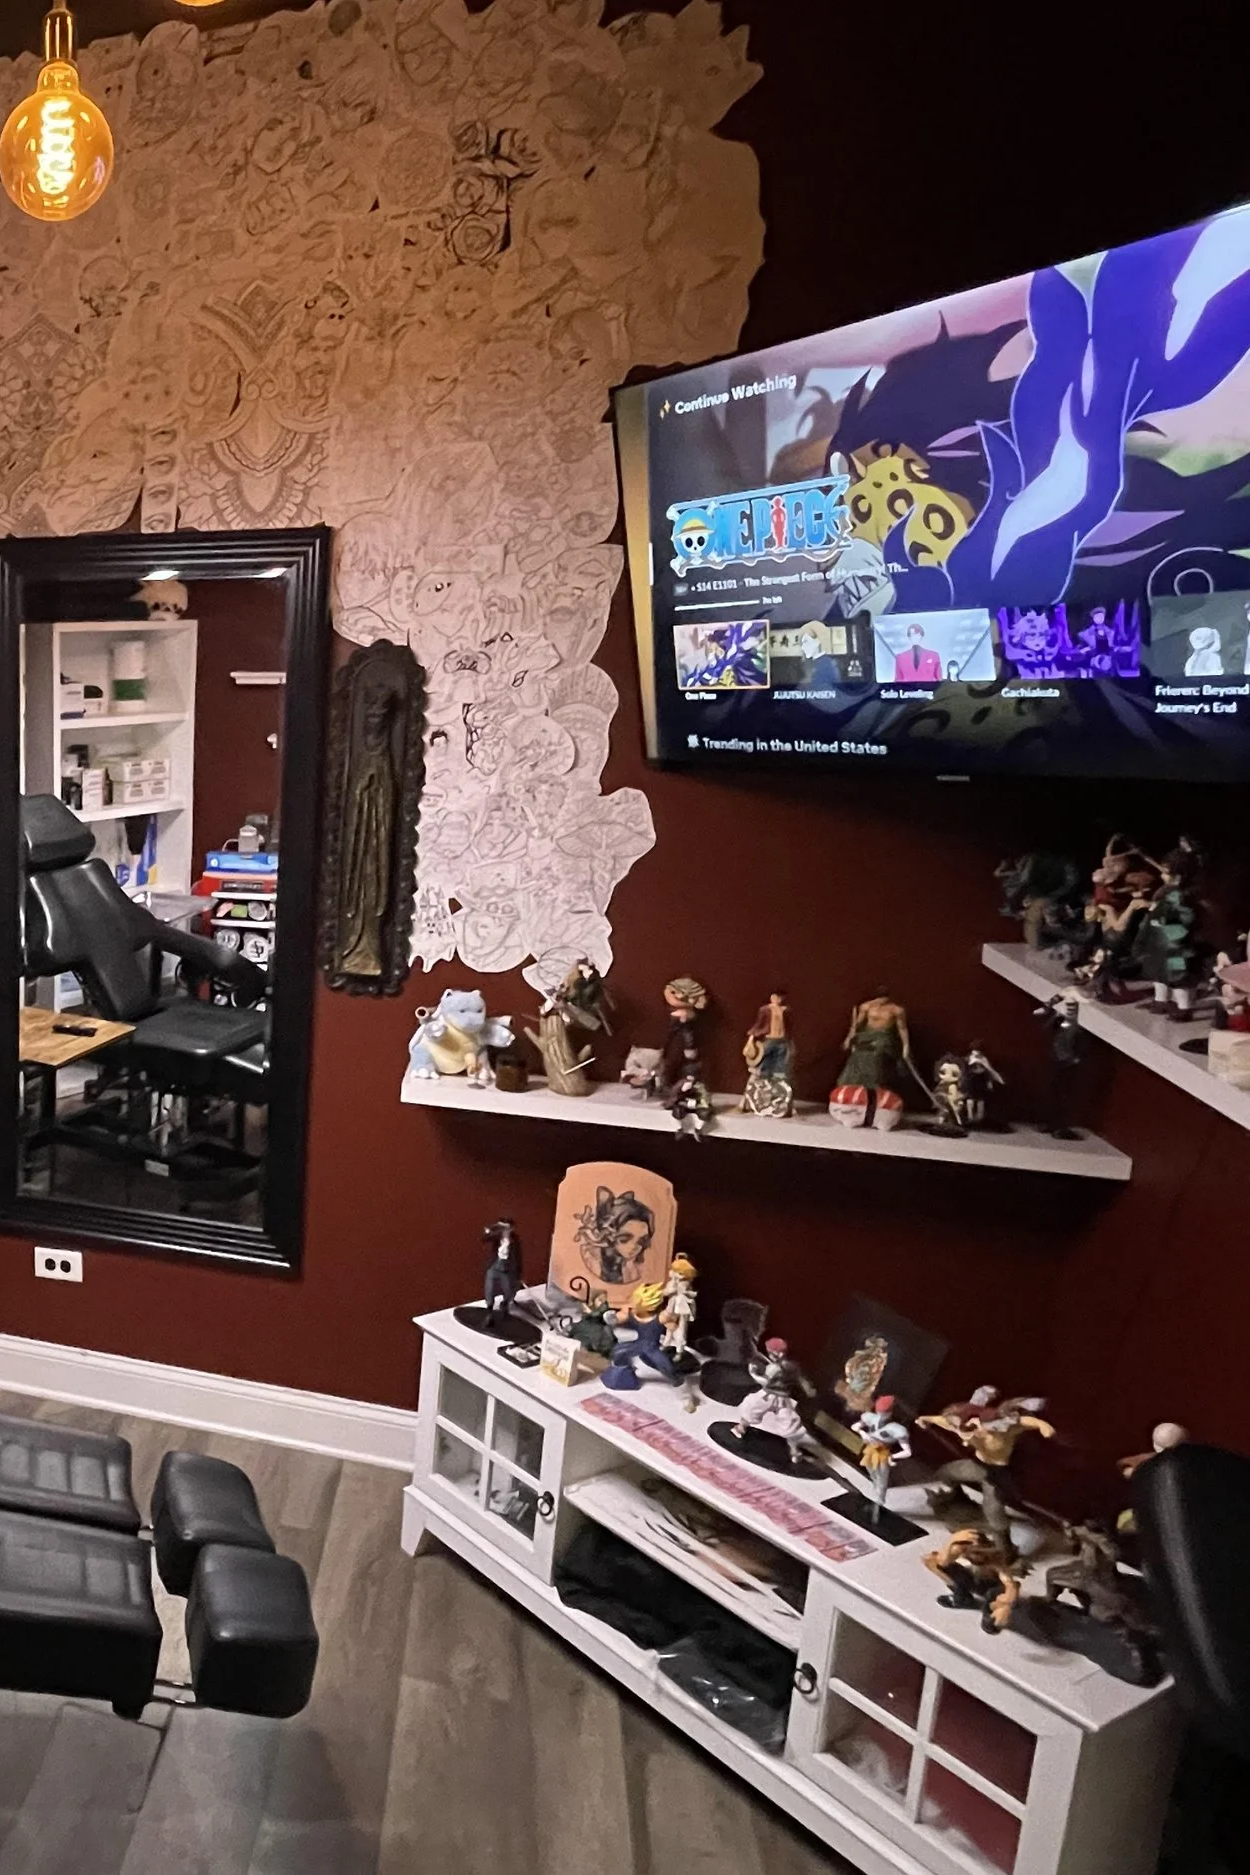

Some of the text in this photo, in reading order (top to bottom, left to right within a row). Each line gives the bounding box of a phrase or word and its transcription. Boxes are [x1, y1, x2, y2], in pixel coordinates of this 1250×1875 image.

[674, 375, 797, 414] Continue Watching
[1202, 684, 1250, 697] Beyond
[1155, 701, 1237, 714] Journey's End
[702, 737, 888, 754] Trending in the United States
